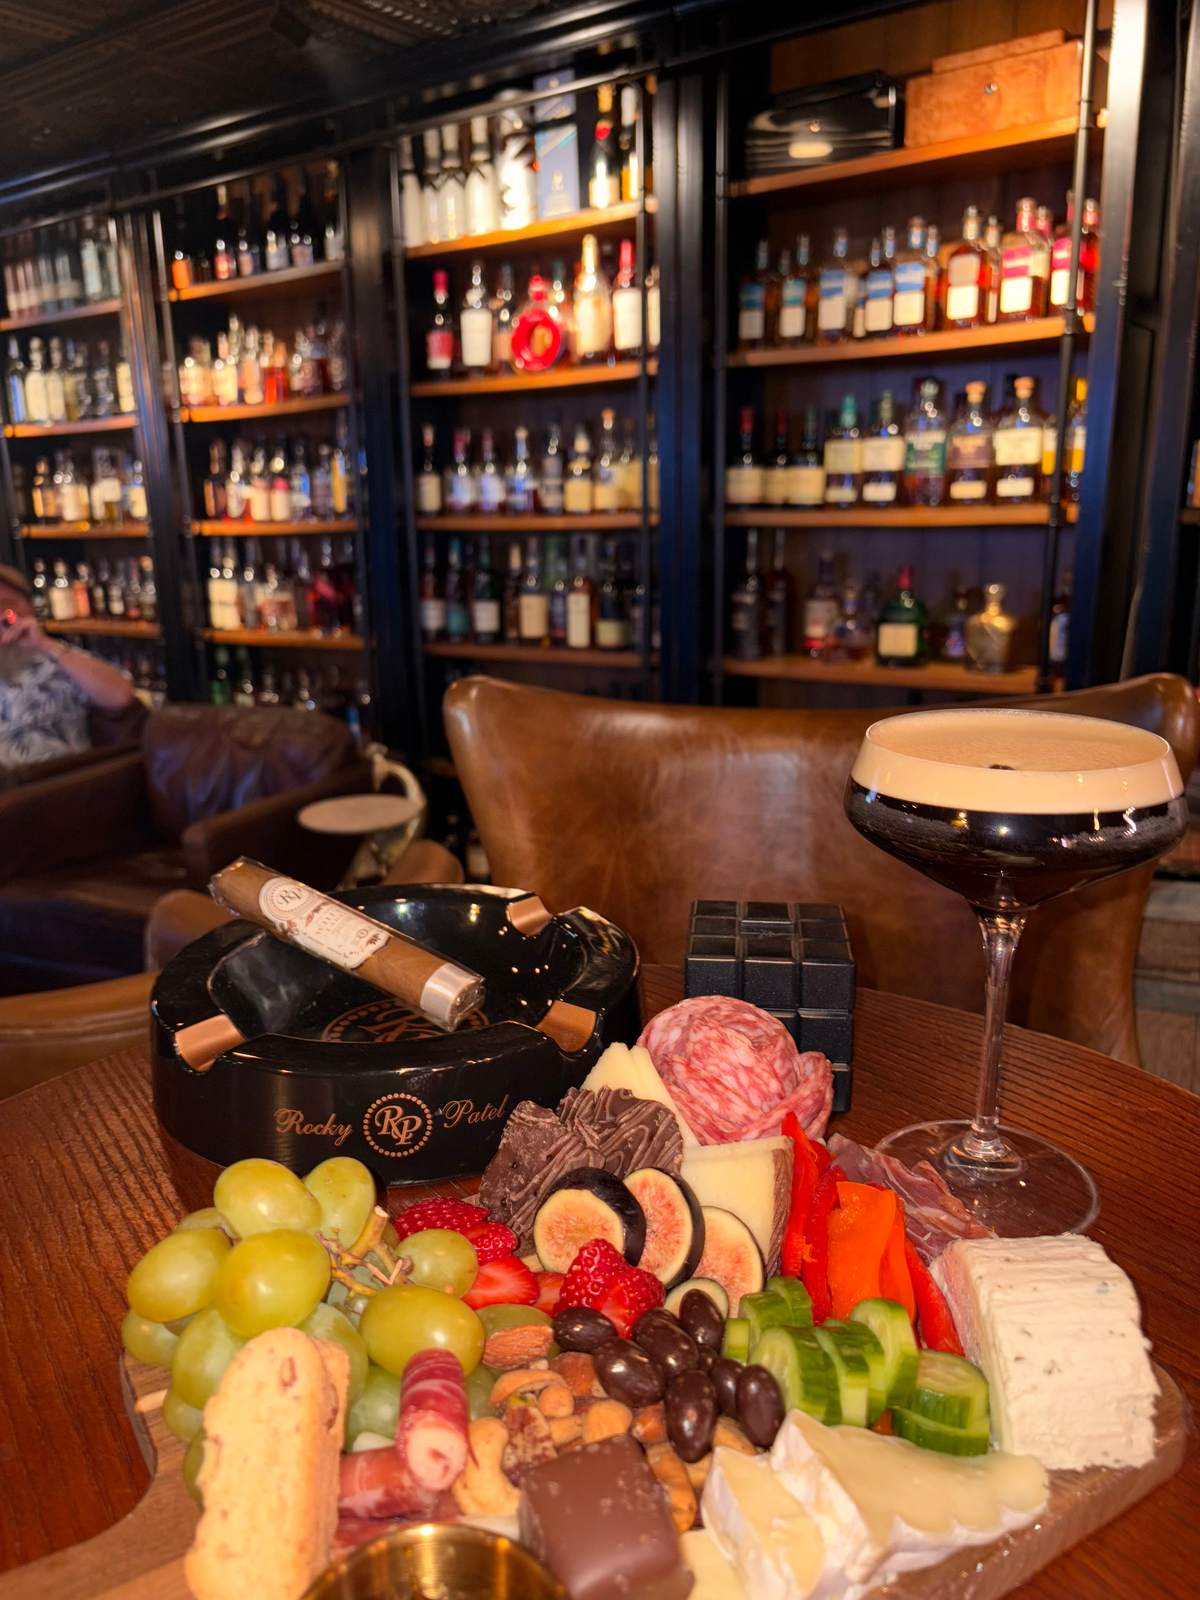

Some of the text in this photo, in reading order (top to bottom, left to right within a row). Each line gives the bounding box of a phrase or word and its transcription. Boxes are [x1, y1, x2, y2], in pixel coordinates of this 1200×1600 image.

[273, 1093, 511, 1147] Rocky RP Patel
